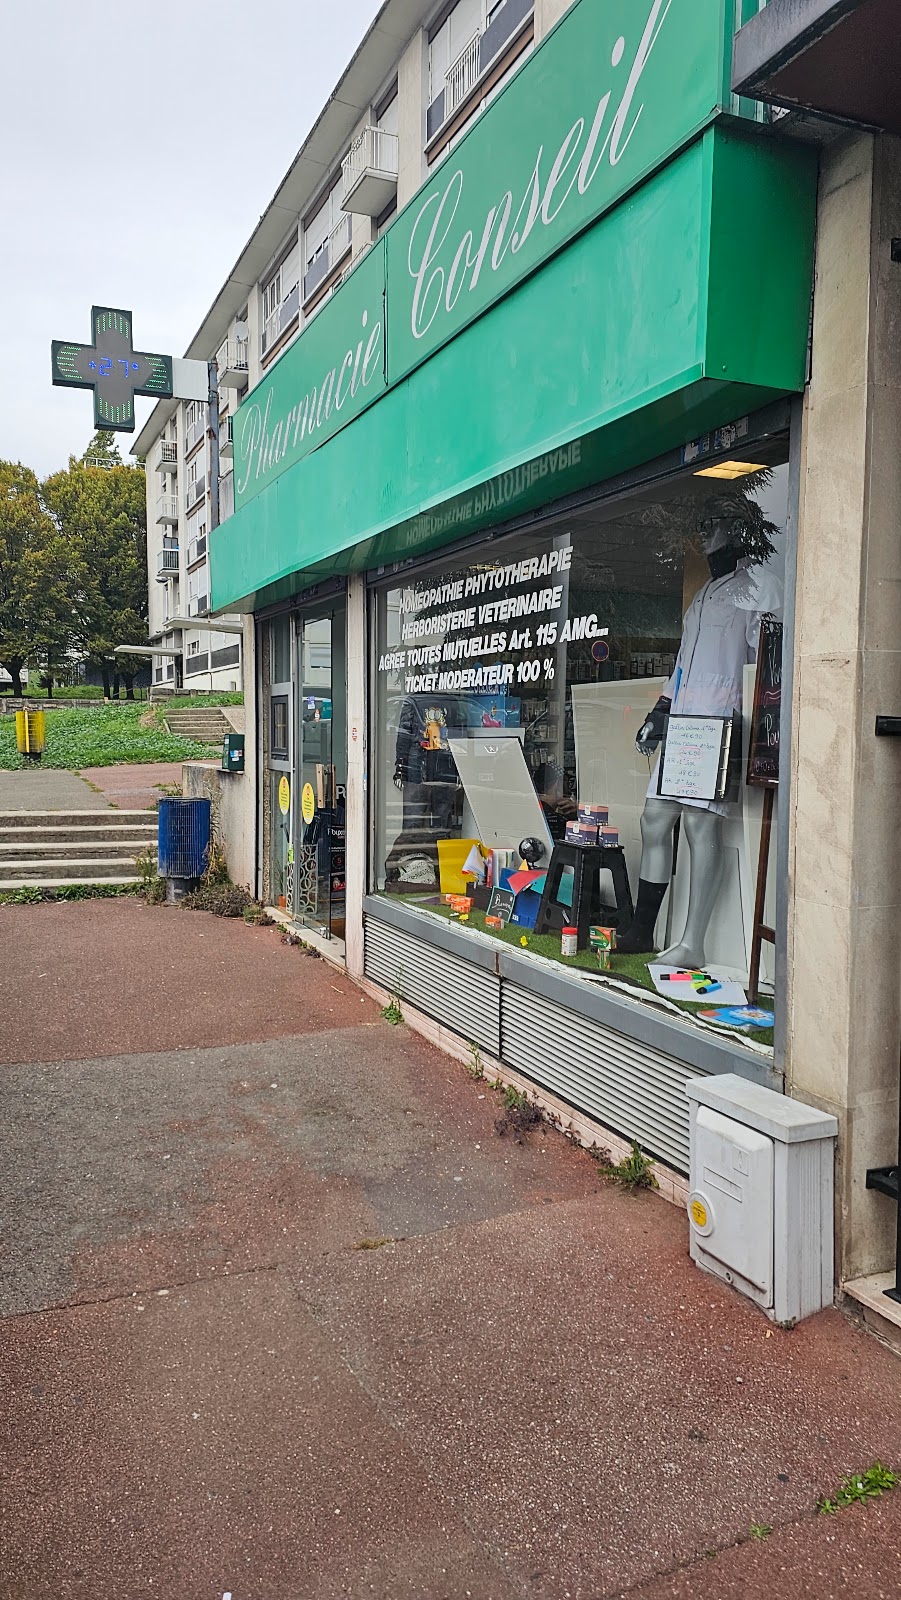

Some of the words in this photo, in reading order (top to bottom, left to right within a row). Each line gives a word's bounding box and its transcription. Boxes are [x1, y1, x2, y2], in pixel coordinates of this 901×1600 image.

[237, 309, 381, 494] Pharmacie
[408, 0, 673, 339] Conseil
[399, 579, 465, 615] HOMEOPATHIE
[464, 546, 574, 598] PHYTOTHERAPIE
[401, 606, 477, 641] HERBORISTERIE
[478, 585, 563, 625] VETERINAIRE
[379, 651, 406, 672] AGREE
[406, 644, 442, 667] TOUTES
[442, 632, 507, 662] MUTUELLES
[508, 628, 533, 651] Art.
[536, 622, 558, 647] 115
[405, 673, 439, 693] TICKET
[439, 663, 514, 691] MODERATEUR
[516, 659, 541, 683] 100
[543, 658, 555, 680] %
